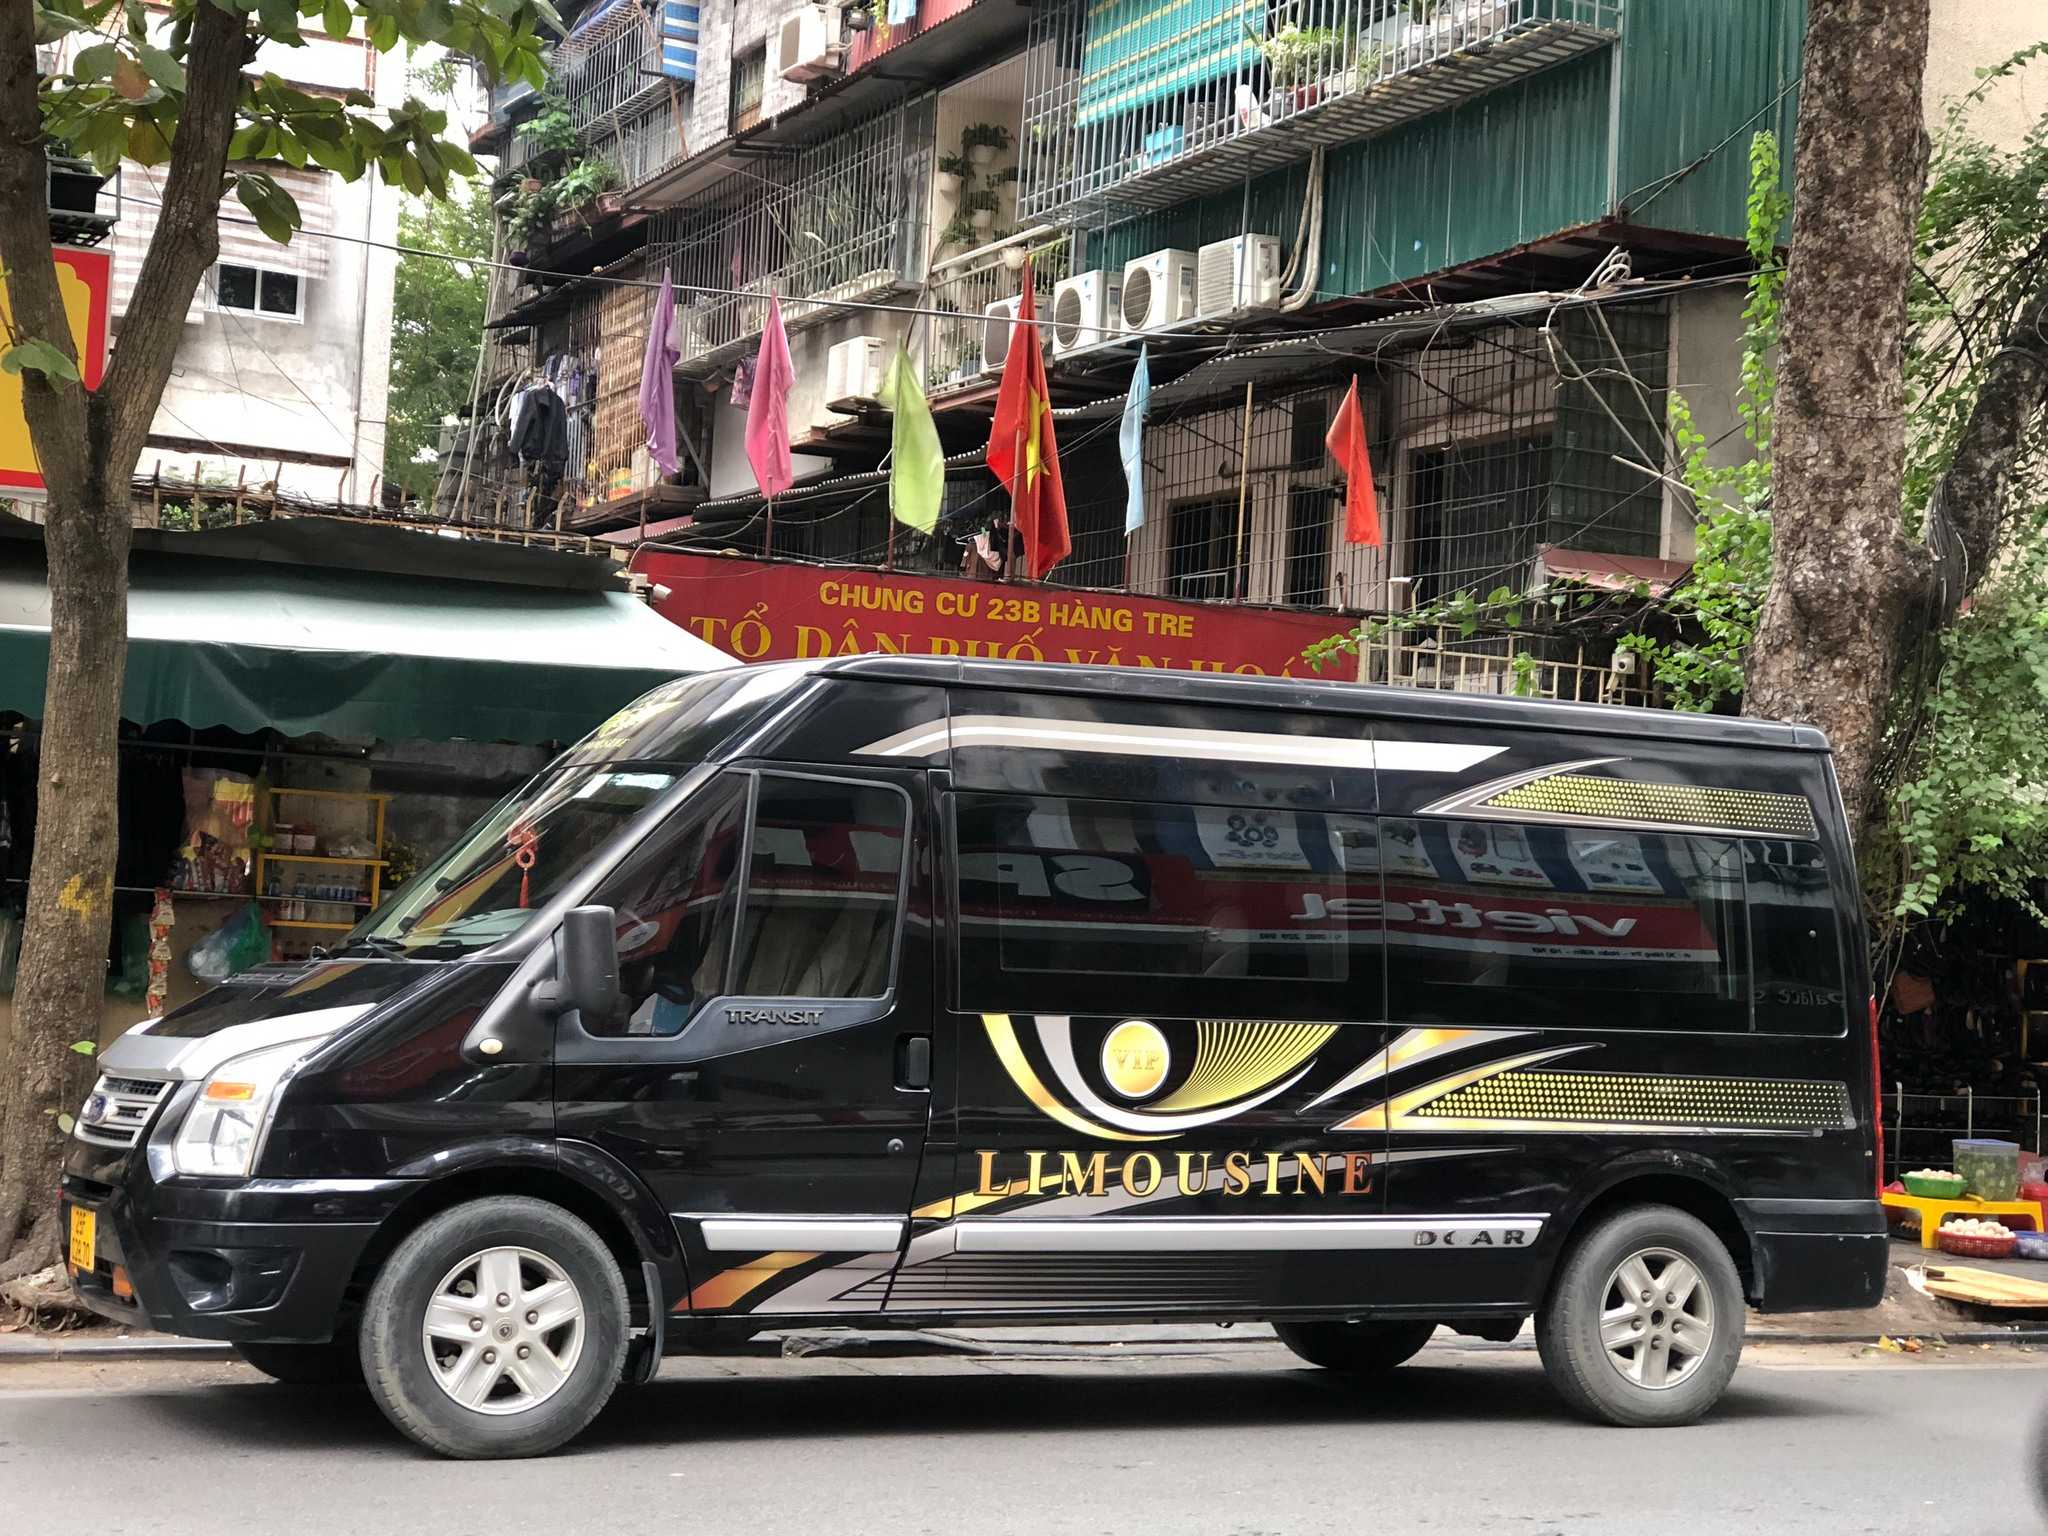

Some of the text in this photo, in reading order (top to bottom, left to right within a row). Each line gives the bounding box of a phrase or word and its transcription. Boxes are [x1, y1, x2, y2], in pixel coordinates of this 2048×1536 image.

[689, 602, 773, 659] TỔ
[819, 581, 1195, 638] CHUNG CƯ 23B HÀNG TRE
[725, 1008, 824, 1025] TRANSIT
[1112, 1048, 1160, 1071] VIP
[974, 1150, 1375, 1198] LIMOUSINE
